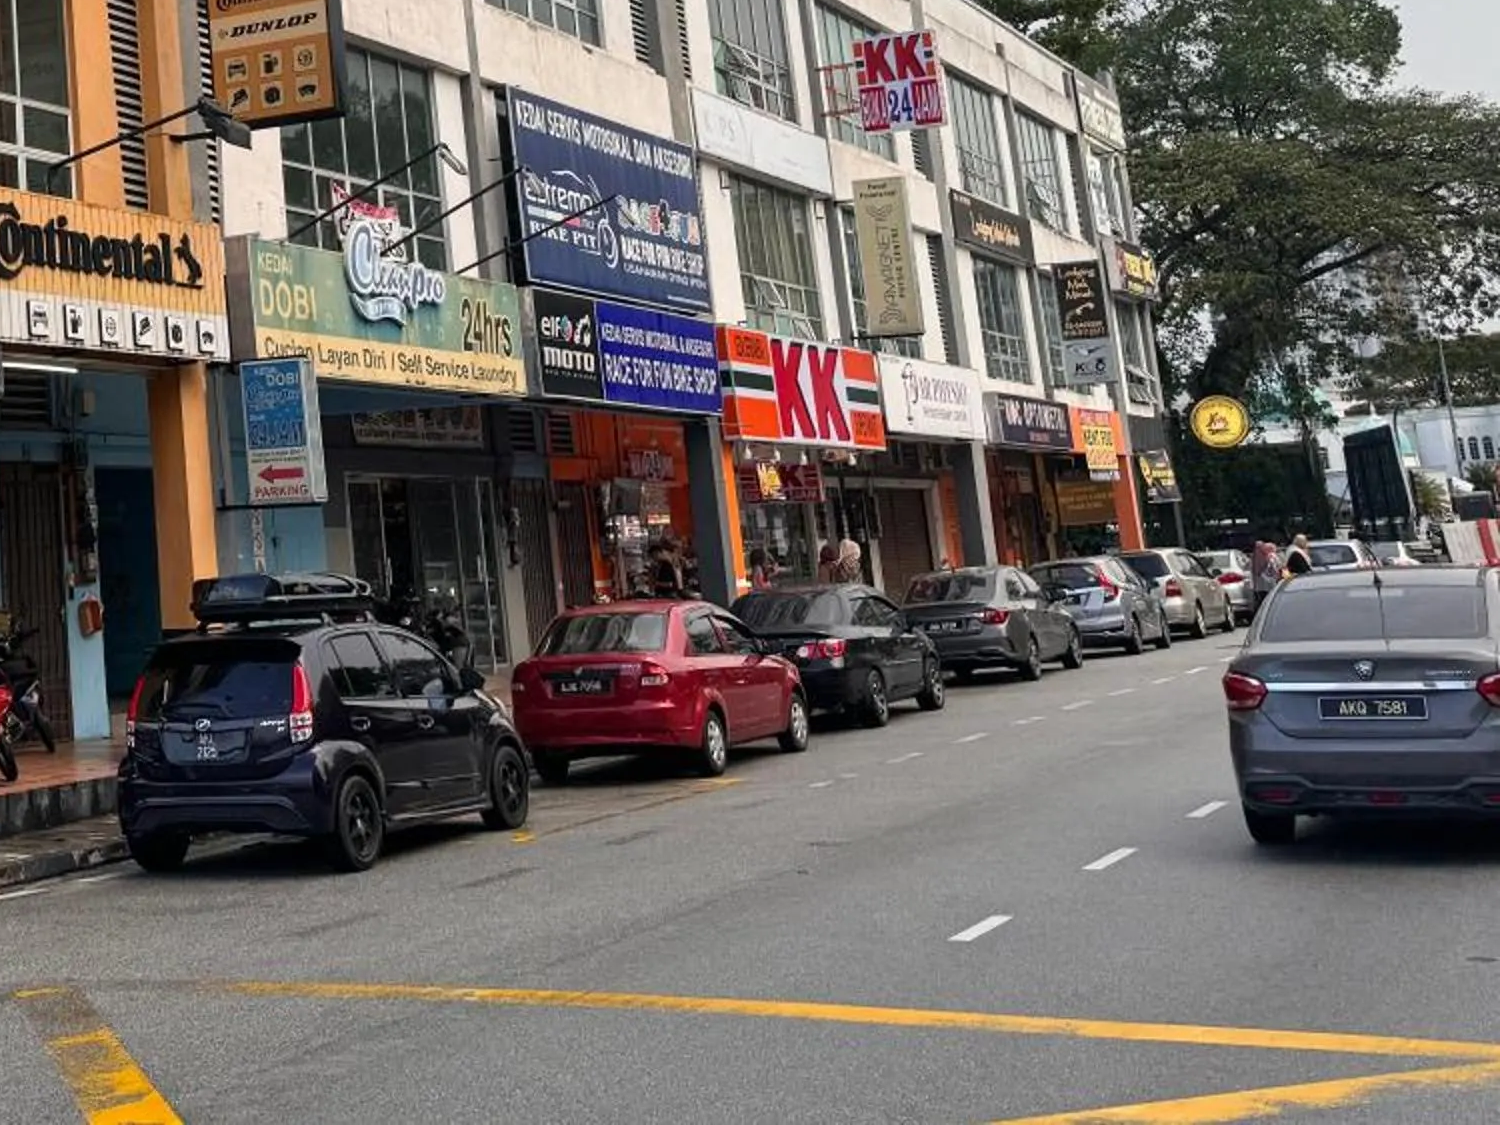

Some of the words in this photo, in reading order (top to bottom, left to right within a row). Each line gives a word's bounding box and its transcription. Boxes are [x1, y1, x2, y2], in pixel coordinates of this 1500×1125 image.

[229, 12, 318, 38] DUNLOP
[864, 34, 926, 84] KK
[515, 99, 546, 133] KEDAI
[888, 87, 913, 123] 24
[572, 230, 597, 249] PIT
[257, 251, 292, 275] KEDAI
[260, 279, 317, 321] DOBI
[461, 296, 513, 357] 24hrs
[266, 372, 299, 386] DOBI
[318, 347, 361, 370] Layan
[364, 348, 387, 369] Diri
[399, 352, 422, 373] Self
[425, 357, 469, 380] Service
[471, 363, 517, 386] Laundry
[604, 354, 633, 385] RACE
[633, 358, 654, 387] FOR
[654, 360, 672, 389] FUN
[693, 367, 717, 395] SHOP
[770, 338, 851, 442] KK
[255, 484, 309, 498] PARKING
[1340, 701, 1367, 715] AKQ
[1373, 700, 1407, 715] 7581
